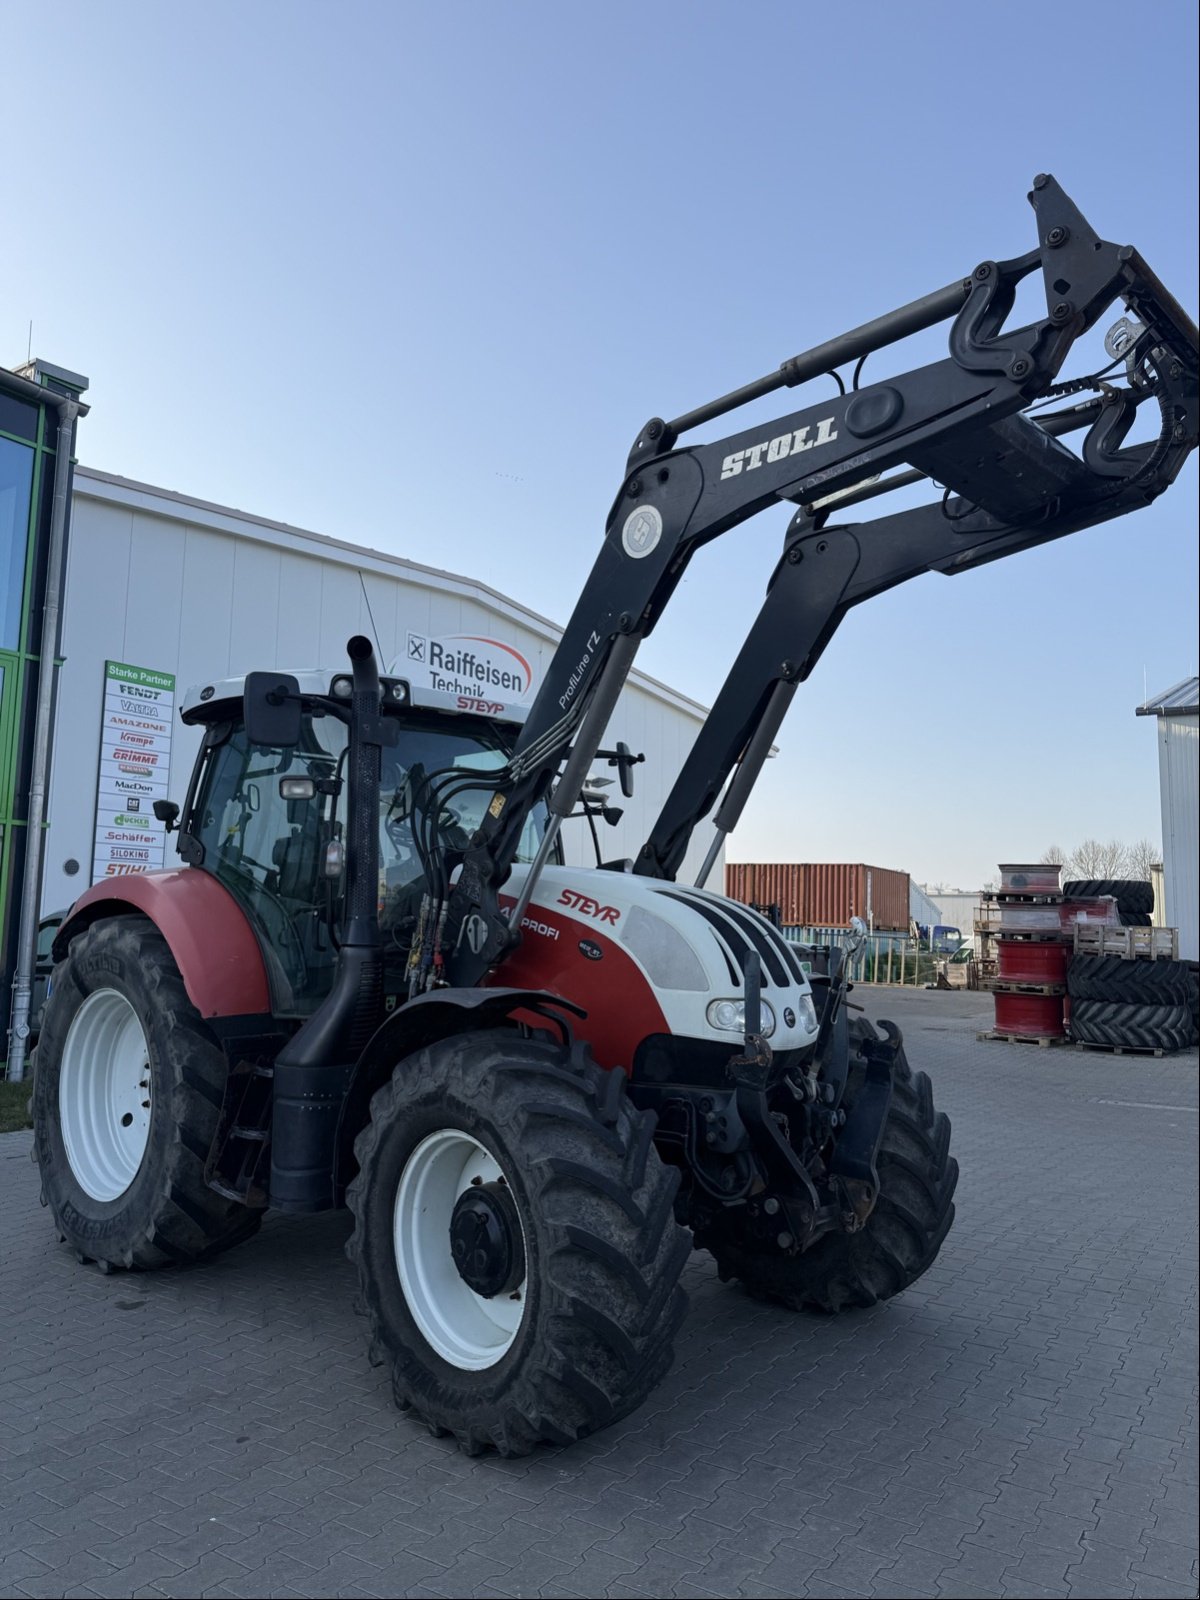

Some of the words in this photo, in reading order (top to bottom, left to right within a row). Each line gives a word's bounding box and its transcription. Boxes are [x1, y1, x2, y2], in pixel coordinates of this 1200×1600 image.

[720, 416, 839, 481] STOLL
[109, 665, 137, 679] Starke
[140, 672, 172, 686] Partner
[429, 641, 522, 693] Raiffeisen
[429, 670, 485, 698] Technik
[558, 653, 591, 710] ProfiLine
[119, 684, 161, 700] FENDT
[120, 699, 158, 717] VALTRA
[110, 716, 166, 731] AMAZONE
[120, 731, 154, 747] Krampe
[112, 750, 157, 765] GRIMME
[114, 780, 152, 791] MacDon
[110, 848, 149, 859] SILOKING
[556, 888, 621, 927] STEYR
[520, 917, 561, 941] PROFI
